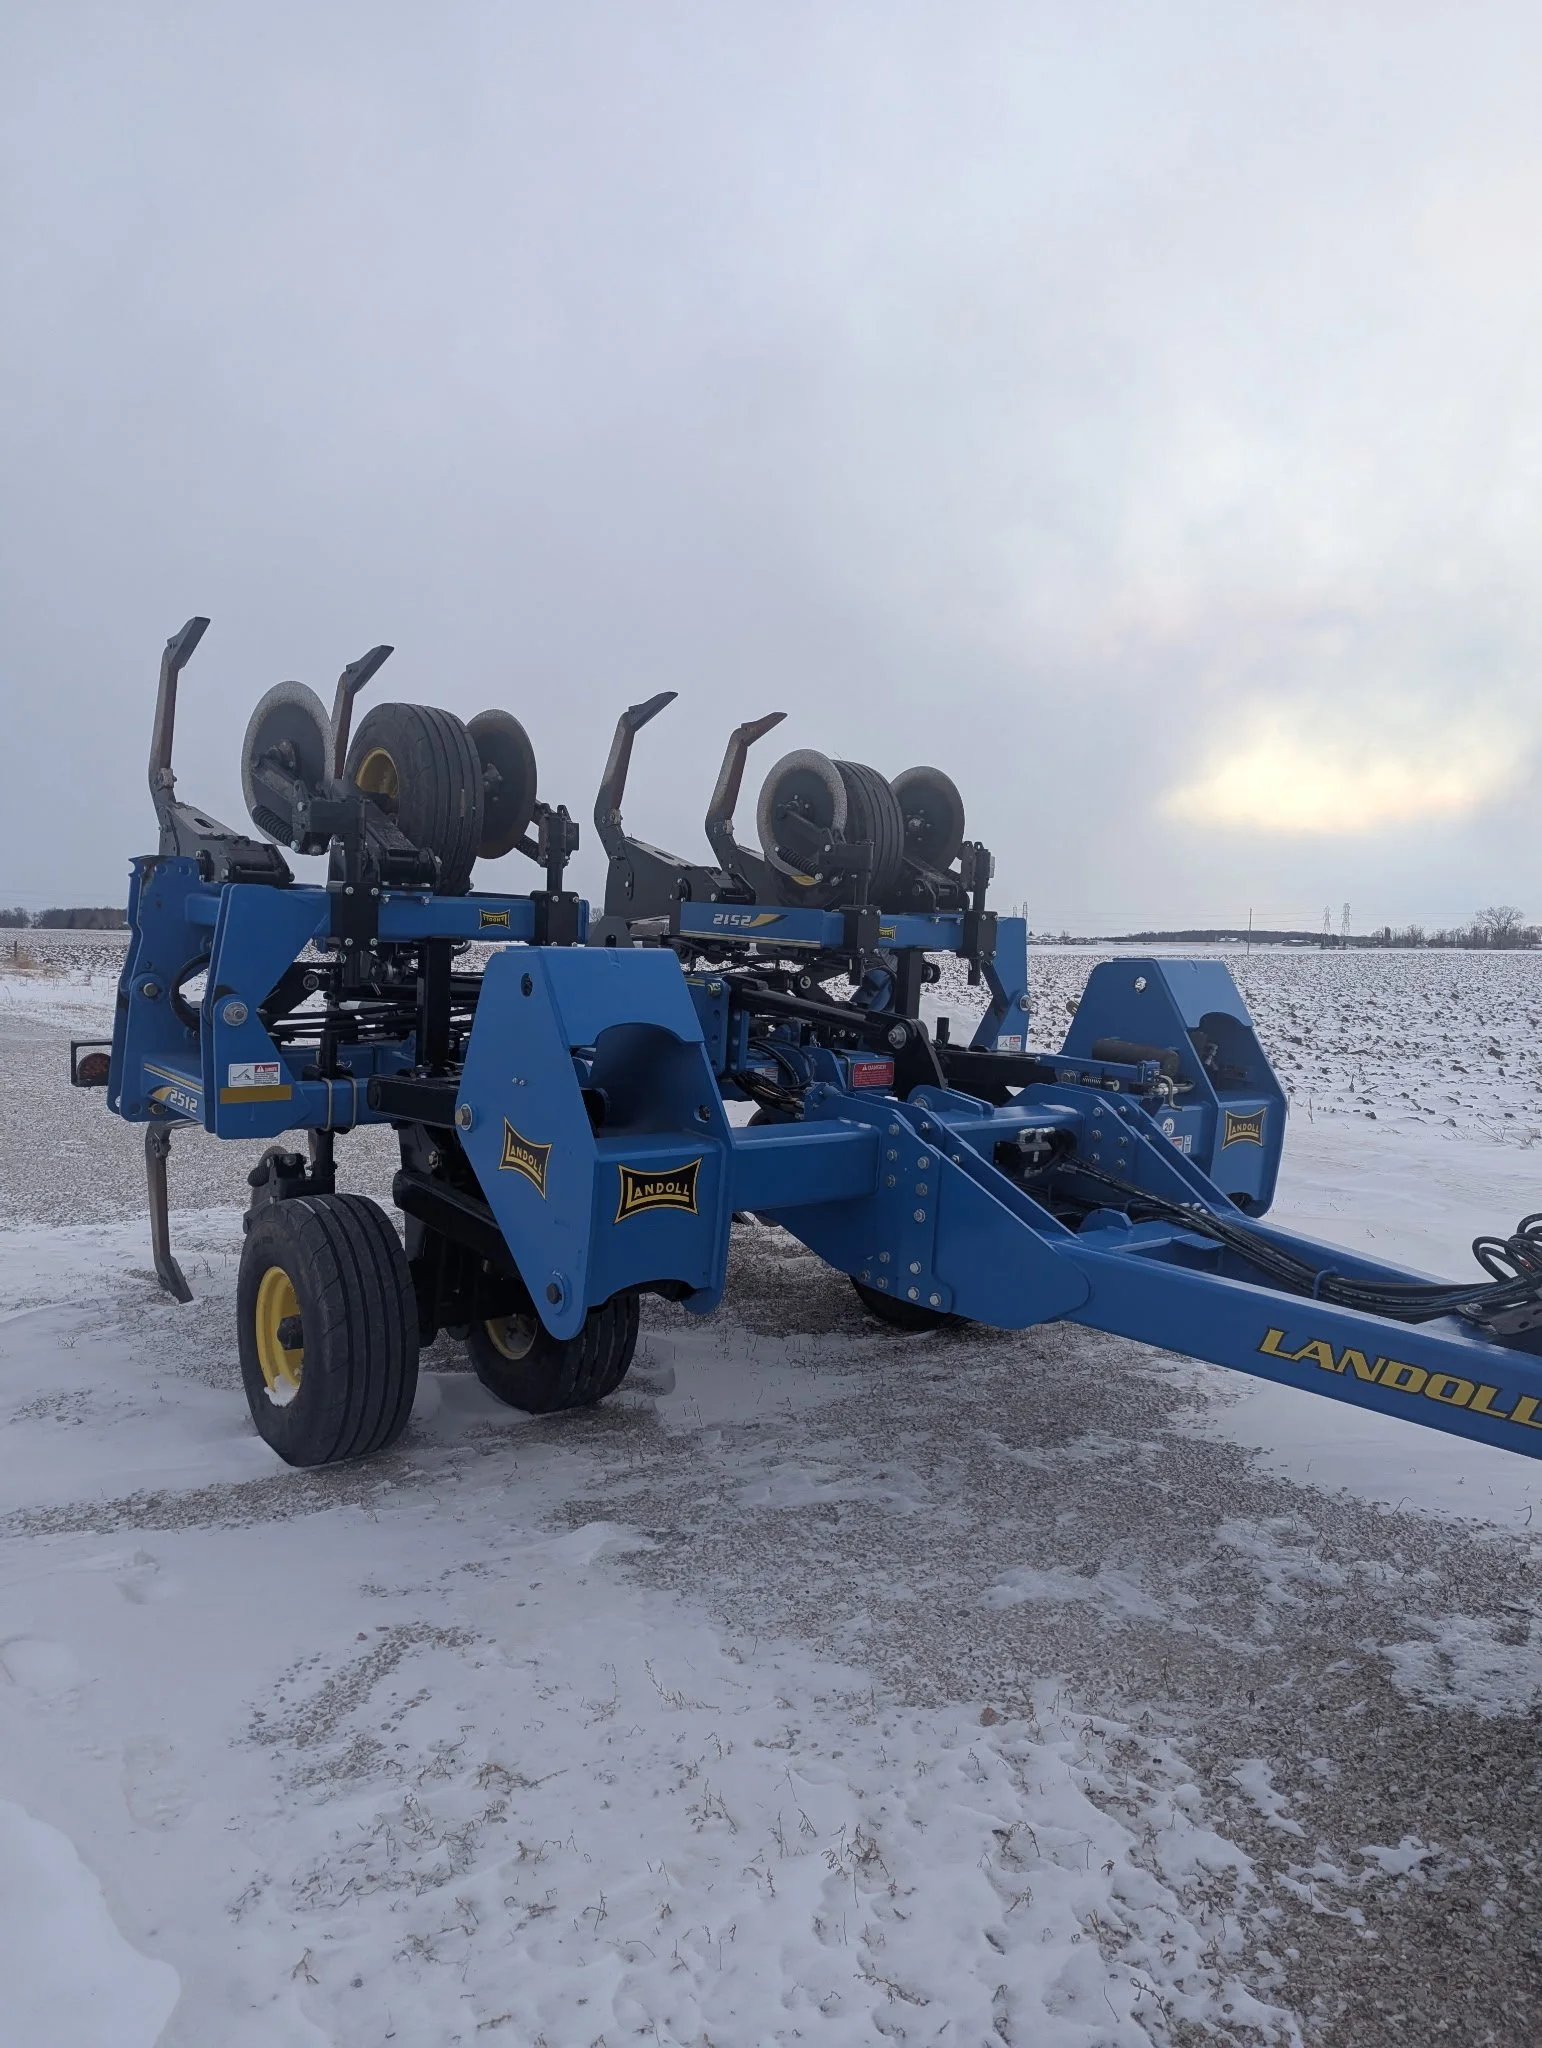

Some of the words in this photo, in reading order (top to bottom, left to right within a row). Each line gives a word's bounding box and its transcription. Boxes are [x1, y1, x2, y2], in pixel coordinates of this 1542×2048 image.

[713, 914, 751, 926] 2512
[170, 1088, 198, 1113] 2512
[1227, 1119, 1260, 1141] LANDOLL
[505, 1131, 543, 1184] LANDOLL
[625, 1177, 690, 1209] LANDOLL
[1259, 1327, 1542, 1429] LANDOLL
